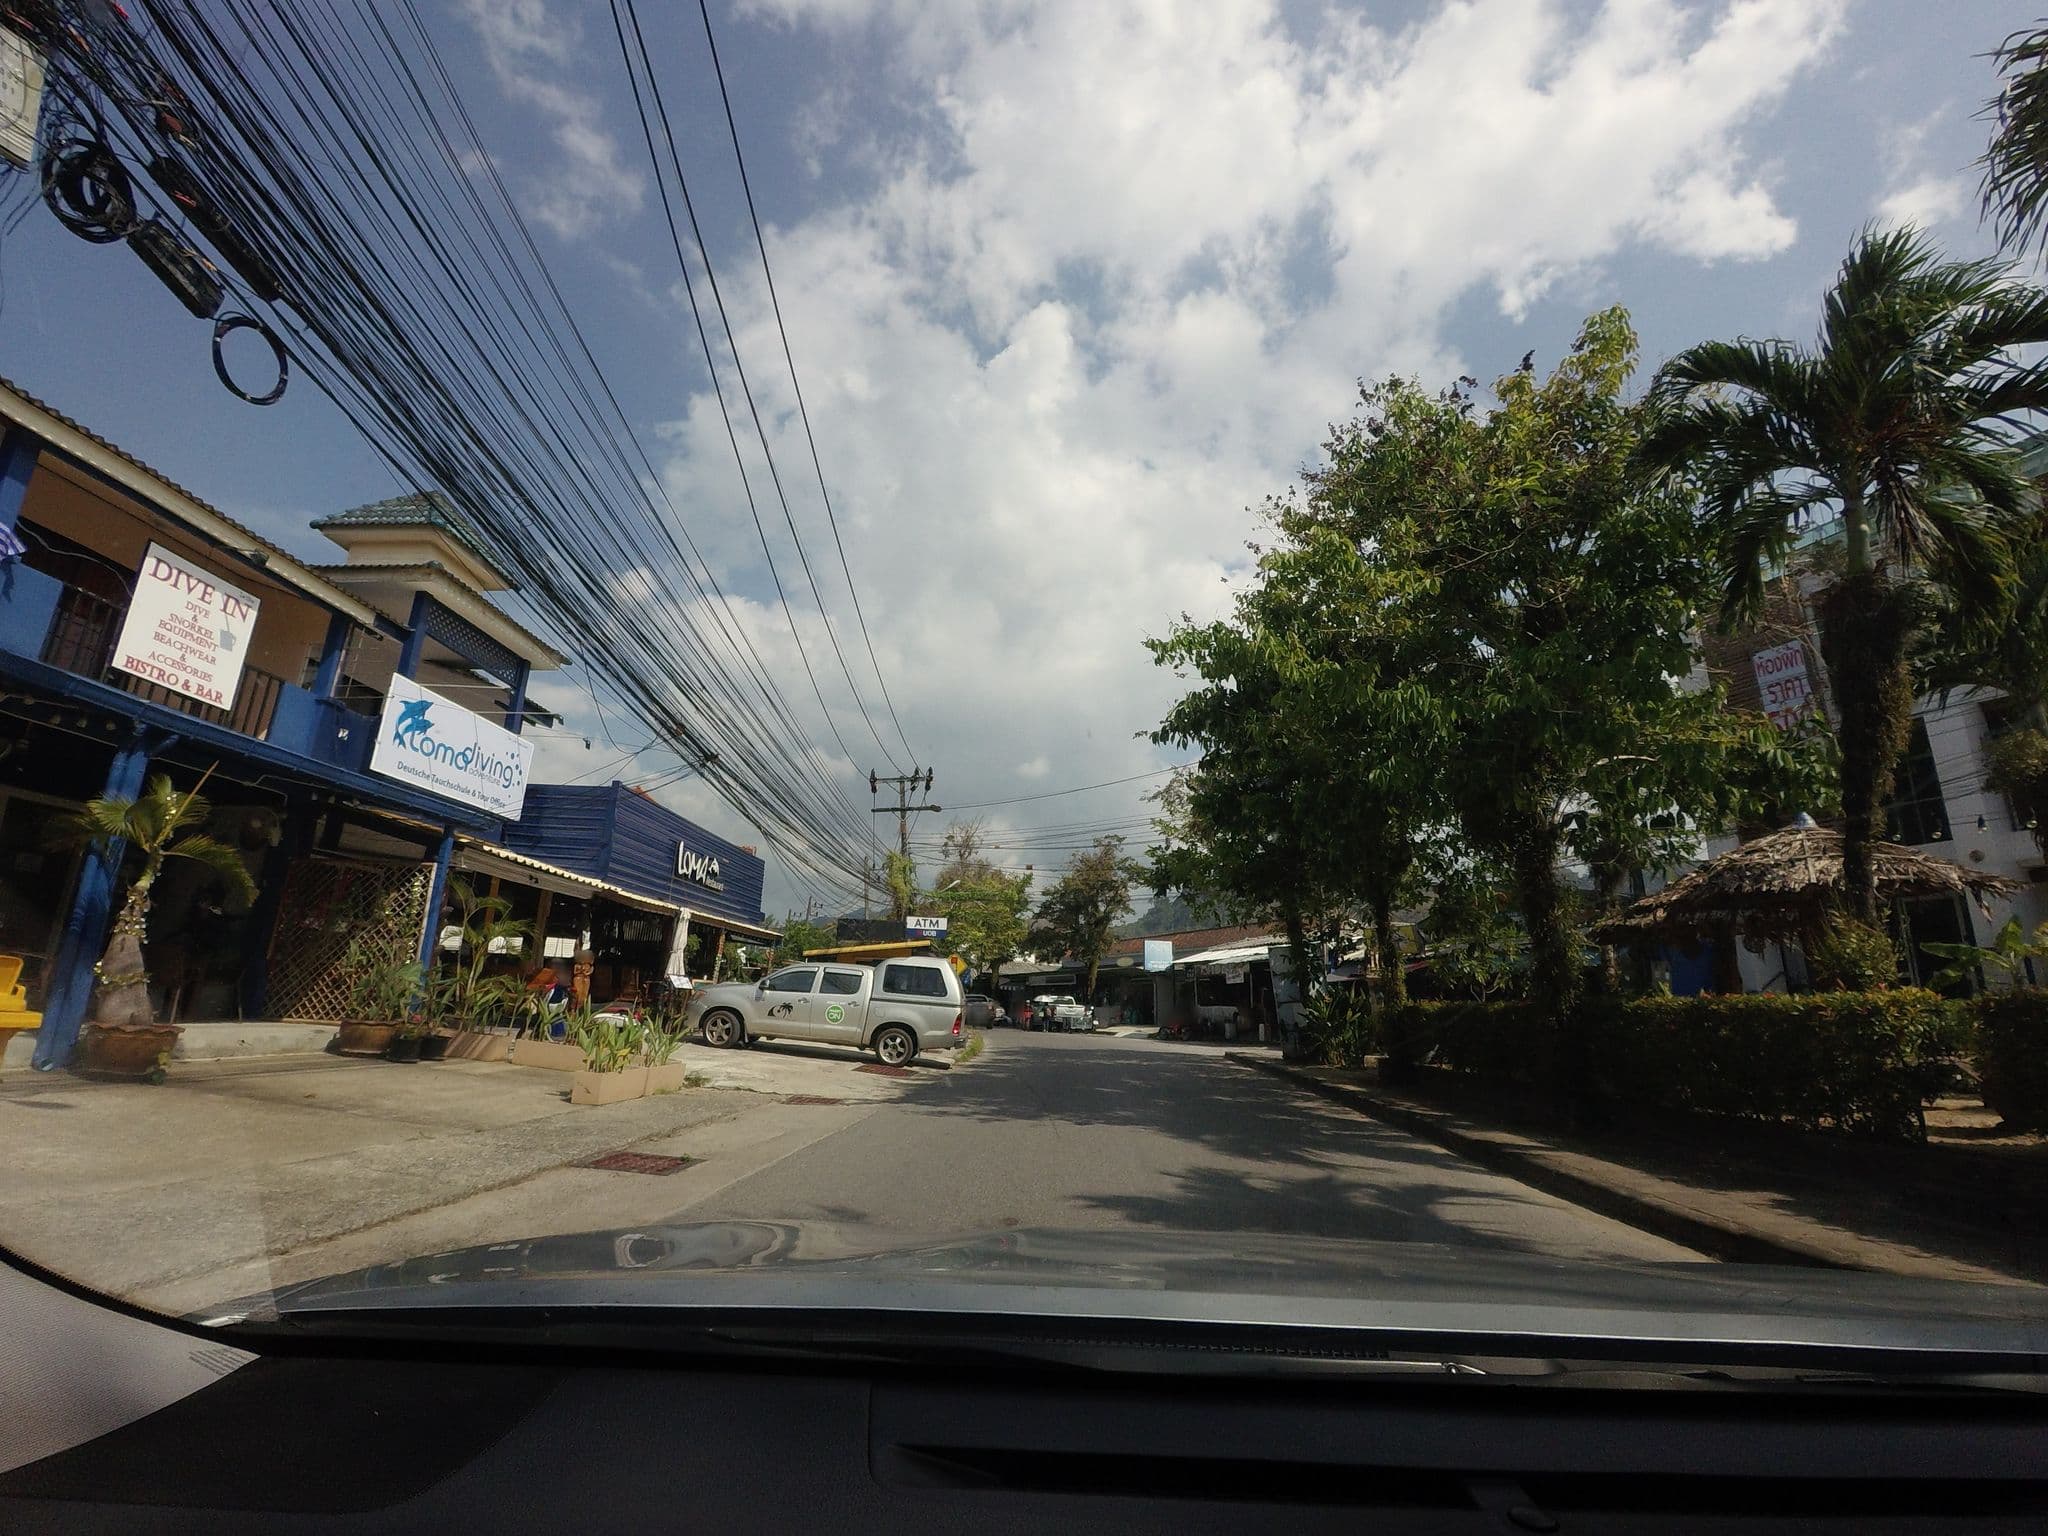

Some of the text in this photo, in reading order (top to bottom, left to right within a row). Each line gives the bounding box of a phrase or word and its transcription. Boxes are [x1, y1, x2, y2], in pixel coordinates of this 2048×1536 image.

[149, 557, 252, 622] DIVE IN
[185, 600, 210, 619] DIVE
[191, 614, 198, 623] &
[158, 619, 219, 653] EQUIPMENT
[168, 613, 215, 641] SNORKEL
[153, 631, 217, 665] BEACHWEAR
[179, 653, 187, 663] &
[123, 654, 224, 705] BISTRO & BAR
[148, 650, 214, 683] ACCESSORIES
[397, 760, 430, 781] Deutsche
[431, 773, 471, 796] Tauchschule
[471, 790, 477, 798] &
[914, 918, 939, 928] ATM
